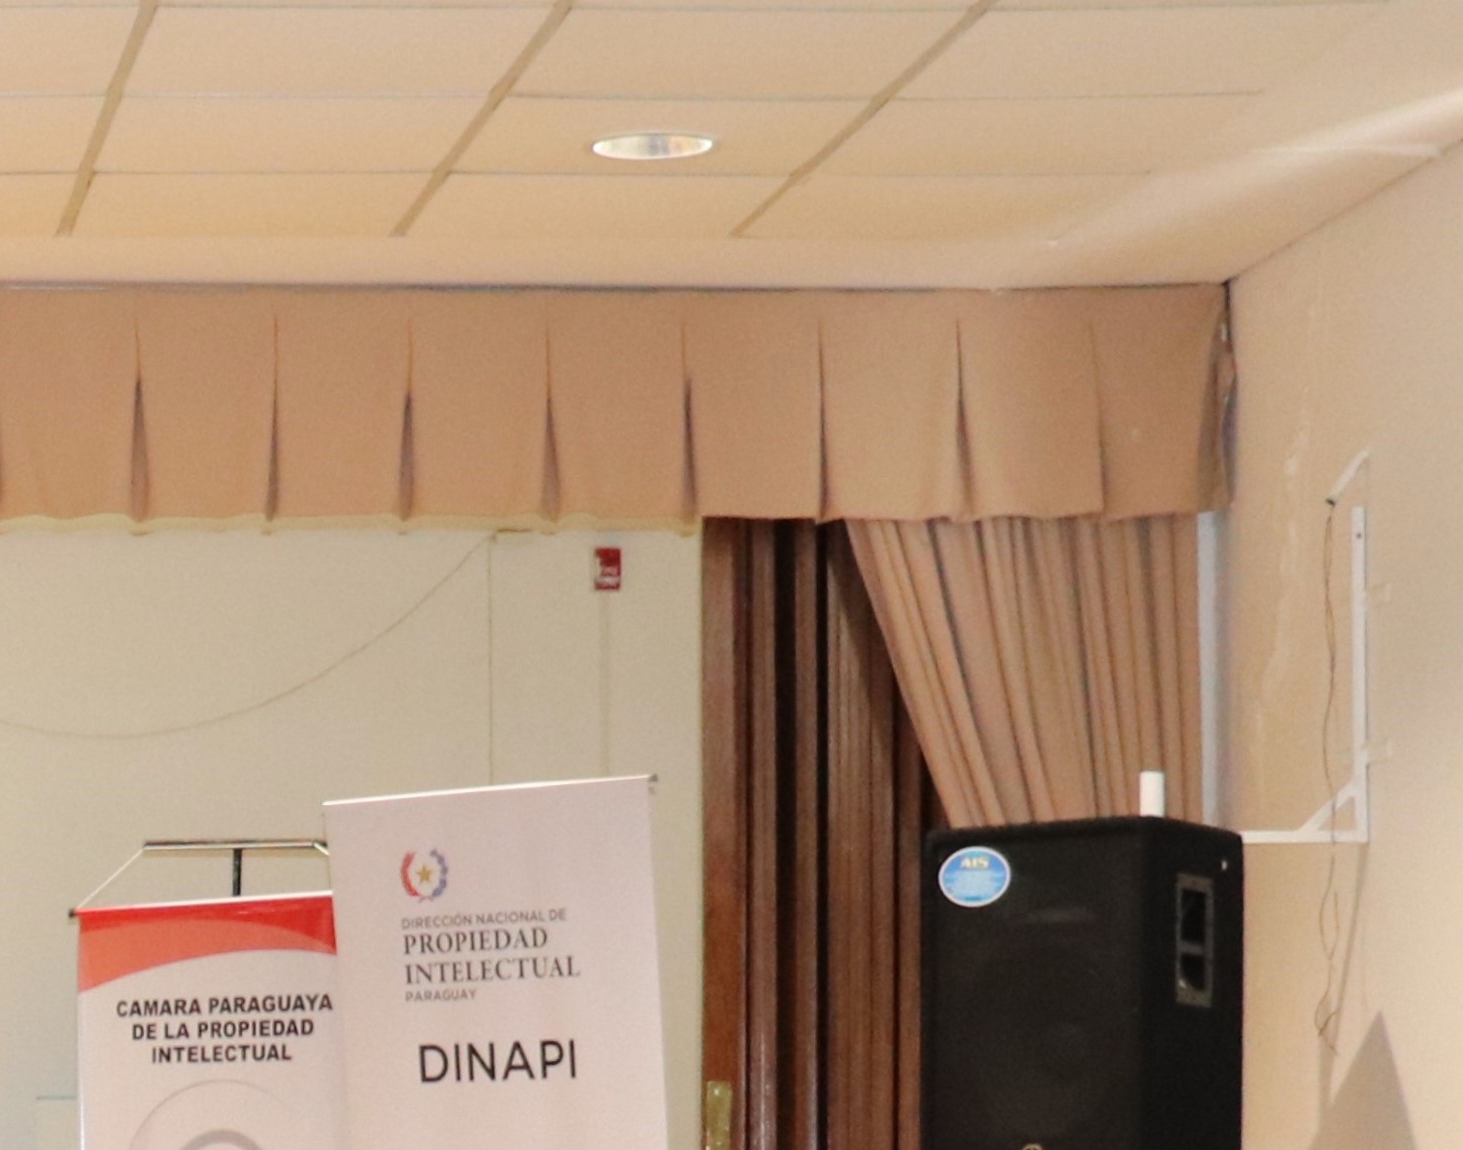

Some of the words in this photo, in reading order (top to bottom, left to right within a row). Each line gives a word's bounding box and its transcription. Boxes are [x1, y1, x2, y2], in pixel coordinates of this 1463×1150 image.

[401, 912, 472, 930] DIRECCIÓN
[476, 911, 546, 926] NACIONAL
[549, 908, 566, 921] DE
[403, 926, 548, 955] PROPIEDAD
[405, 955, 581, 985] INTELECTUAL
[116, 998, 201, 1017] CAMARA
[208, 994, 333, 1014] PARAGUAYA
[405, 989, 477, 1002] PARAGUAY
[132, 1023, 157, 1040] DE
[164, 1023, 189, 1039] LA
[197, 1019, 314, 1038] PROPIEDAD
[152, 1044, 292, 1064] INTELECTUAL
[419, 1038, 577, 1083] DINAPI
